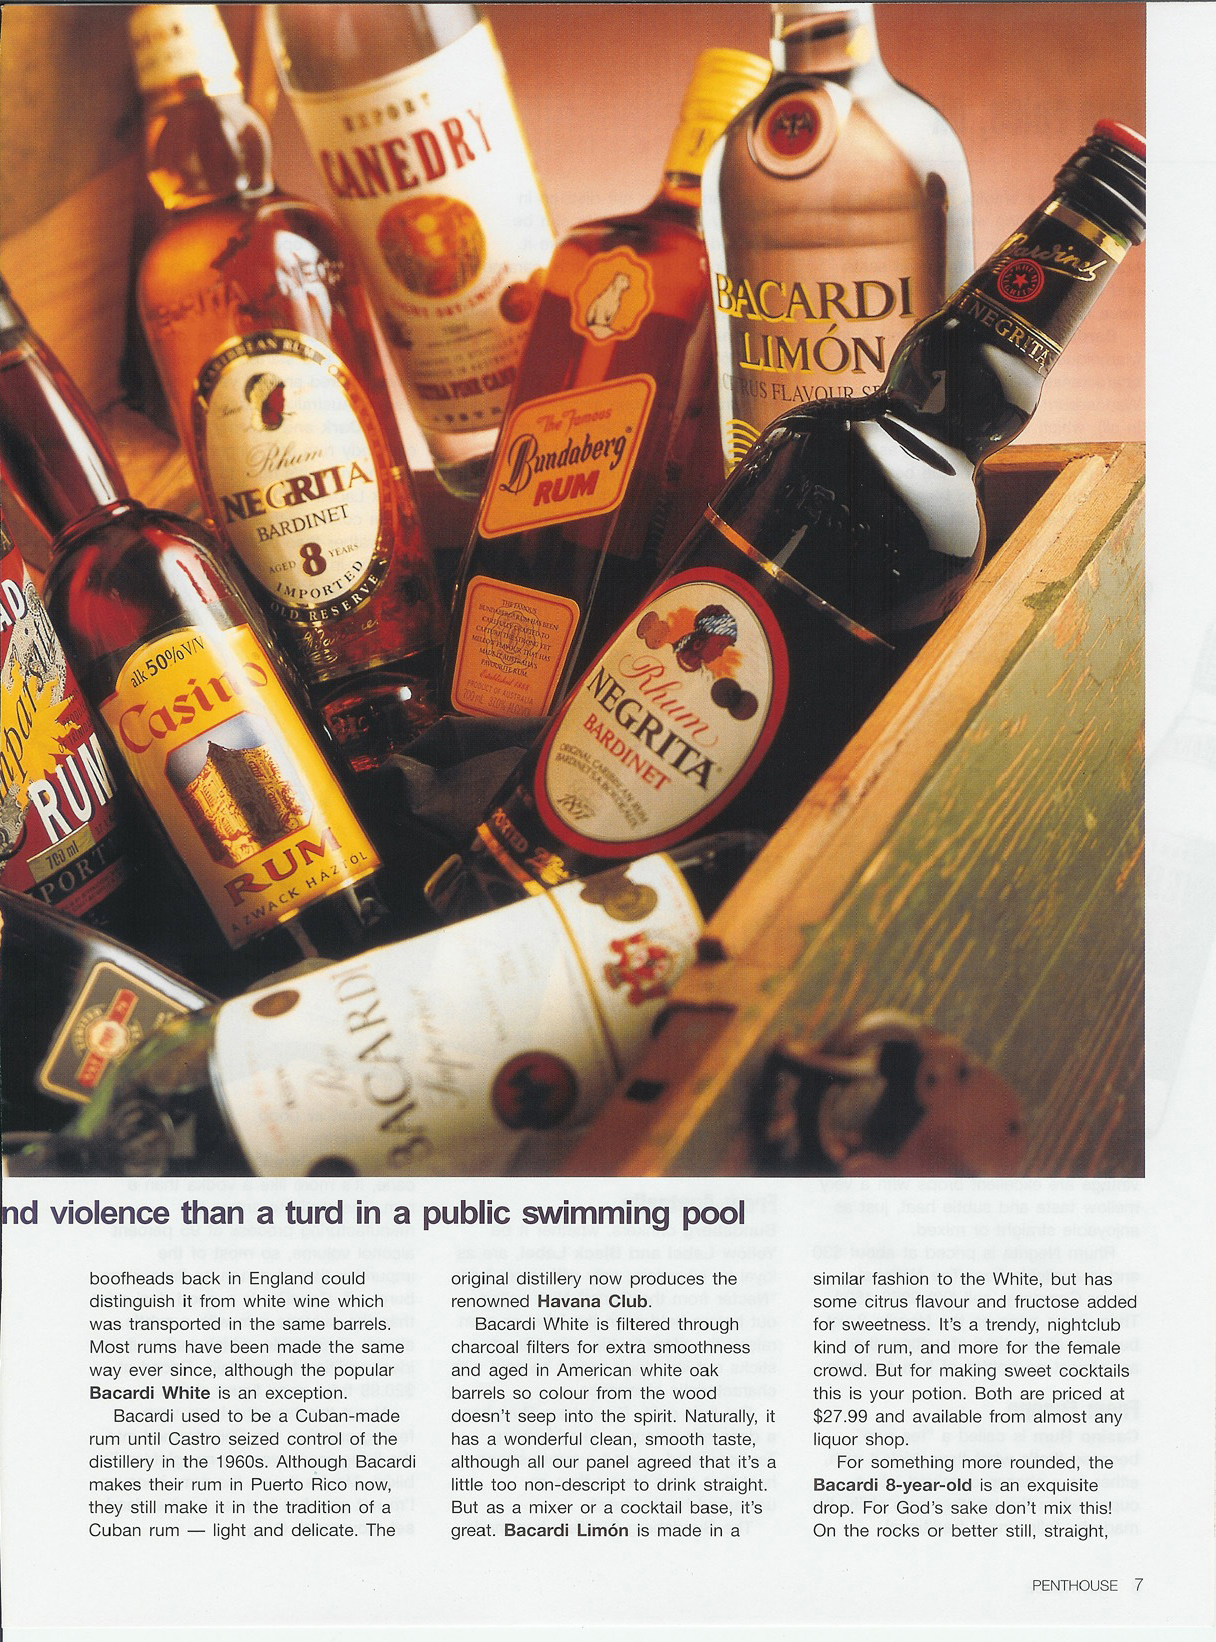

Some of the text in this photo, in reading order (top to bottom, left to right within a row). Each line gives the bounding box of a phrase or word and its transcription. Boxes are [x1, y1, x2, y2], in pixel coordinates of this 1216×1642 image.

[320, 108, 492, 199] CANEDRY
[716, 275, 914, 323] BACARDI
[739, 323, 886, 374] LIMÓN
[968, 300, 1051, 365] NEGRITA
[771, 383, 854, 402] FLAVOUR
[537, 408, 612, 437] The Famous
[246, 440, 325, 477] Rhum
[499, 433, 627, 496] Bundaberg
[218, 461, 374, 523] NEGRITA
[533, 470, 600, 506] RUM
[256, 503, 349, 543] BARDINET
[269, 542, 359, 577] AGED 8 YEARS
[275, 560, 364, 600] IMPORTED
[270, 574, 379, 621] OLD RESERVE
[130, 635, 205, 688] alk 50% V/V
[118, 660, 268, 754] Casino
[618, 653, 719, 748] Rhum
[587, 665, 714, 790] NEGRITA
[583, 713, 671, 790] BARDINET
[28, 732, 114, 844] RUM
[46, 840, 80, 871] 700 ml
[223, 827, 342, 907] RUM
[244, 887, 300, 925] ZWACK
[329, 963, 434, 1169] BACARDI
[50, 1200, 169, 1224] violence
[181, 1200, 243, 1224] than
[257, 1206, 273, 1224] a
[285, 1200, 342, 1224] turd
[357, 1200, 380, 1224] in
[394, 1206, 410, 1224] a
[424, 1200, 510, 1230] public
[522, 1200, 669, 1231] swimming
[683, 1200, 744, 1230] pool
[814, 1408, 1122, 1426] $27.99 and available from almost any
[451, 1523, 739, 1540] great. Bacardi Limón is made in a
[1033, 1578, 1144, 1592] PENTHOUSE 7
